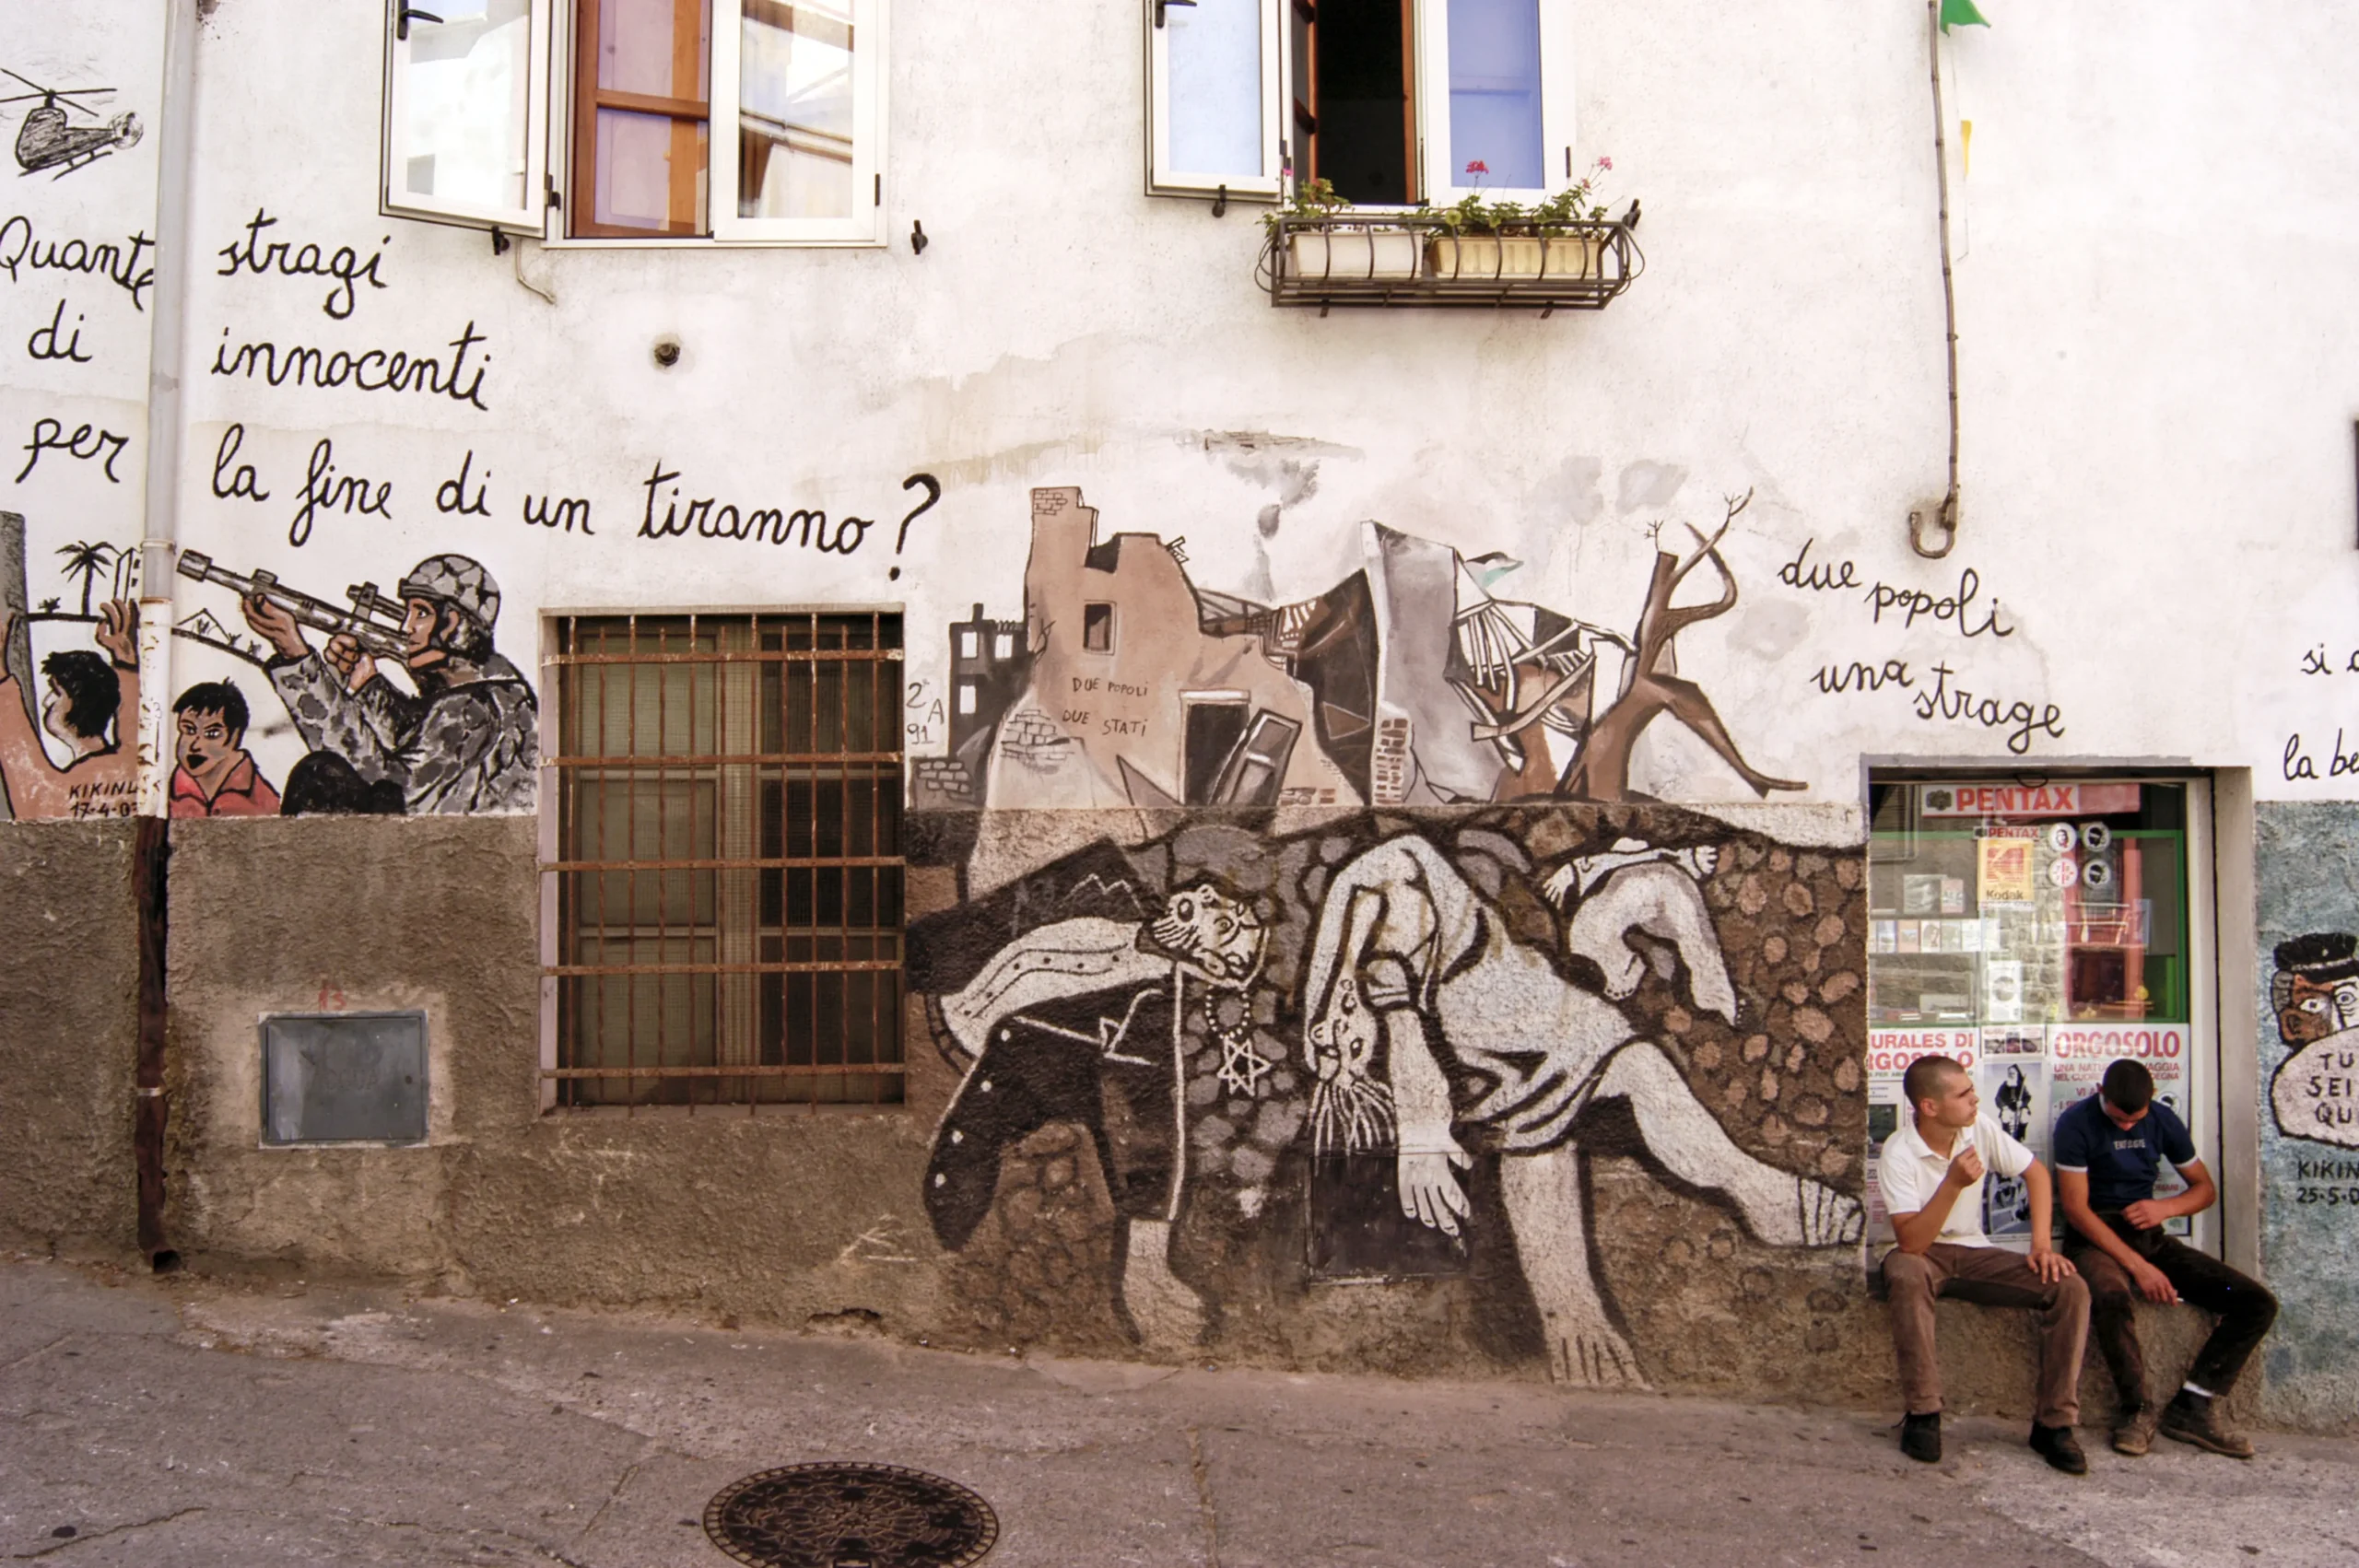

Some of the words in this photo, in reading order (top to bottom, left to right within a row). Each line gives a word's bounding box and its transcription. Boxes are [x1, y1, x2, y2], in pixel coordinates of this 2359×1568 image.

[217, 208, 391, 320] stragi
[28, 299, 92, 362] di
[211, 321, 489, 411] innocenti
[16, 418, 129, 484] per
[212, 423, 270, 501] la
[288, 439, 393, 547] fine
[436, 451, 492, 517] di
[522, 494, 595, 534] un
[1778, 537, 1861, 591] due
[1864, 568, 2013, 637] popoli
[2300, 643, 2332, 675] si
[1072, 677, 1100, 693] DUE
[1062, 708, 1091, 725] DUE
[1810, 660, 1914, 693] una
[1913, 661, 2065, 755] strage
[2283, 733, 2319, 781] la
[1956, 786, 2074, 812] PENTAX
[1988, 826, 2040, 838] PENTAX
[1986, 889, 2025, 900] Kodak
[1872, 1033, 1946, 1049] URALES
[1954, 1033, 1974, 1048] DI
[2054, 1031, 2180, 1059] ORGOSOLO
[2319, 1052, 2354, 1071] TU
[2306, 1076, 2352, 1097] SEI
[2315, 1102, 2359, 1129] QU
